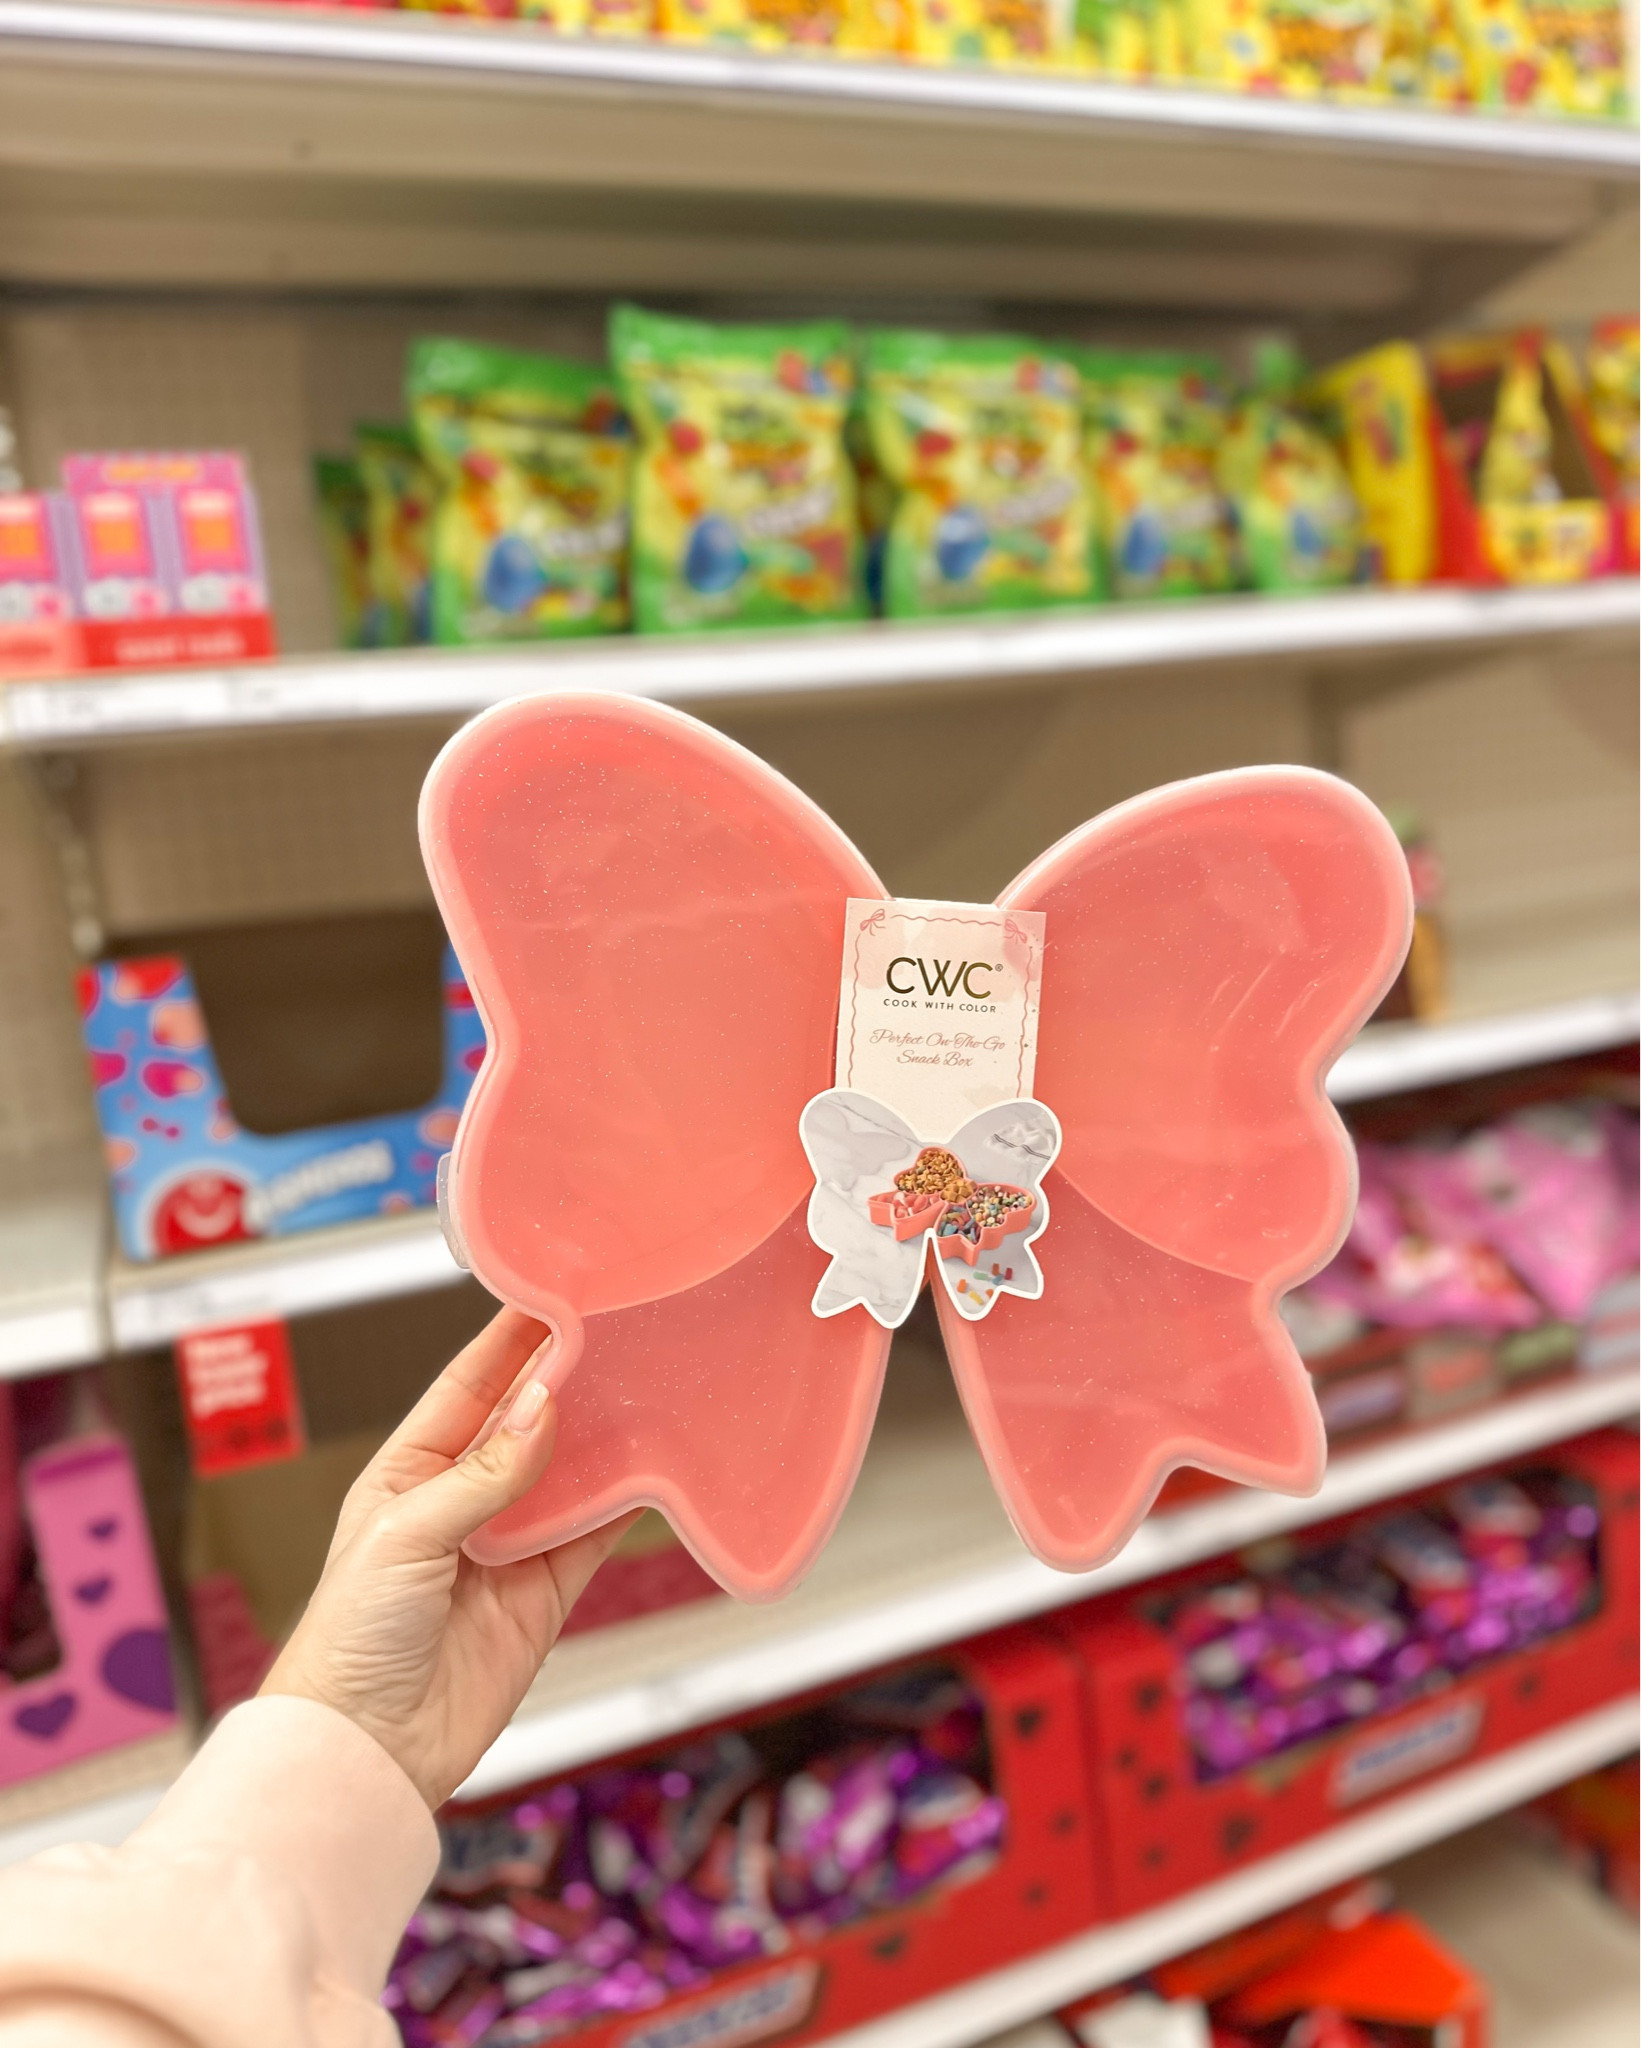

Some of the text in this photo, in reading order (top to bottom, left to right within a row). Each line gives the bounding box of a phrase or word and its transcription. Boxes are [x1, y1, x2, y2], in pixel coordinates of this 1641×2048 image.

[883, 998, 997, 1013] COOK WITH COLOR
[869, 1028, 1006, 1051] Perfect On-The-Go
[896, 1049, 974, 1067] Snack Box
